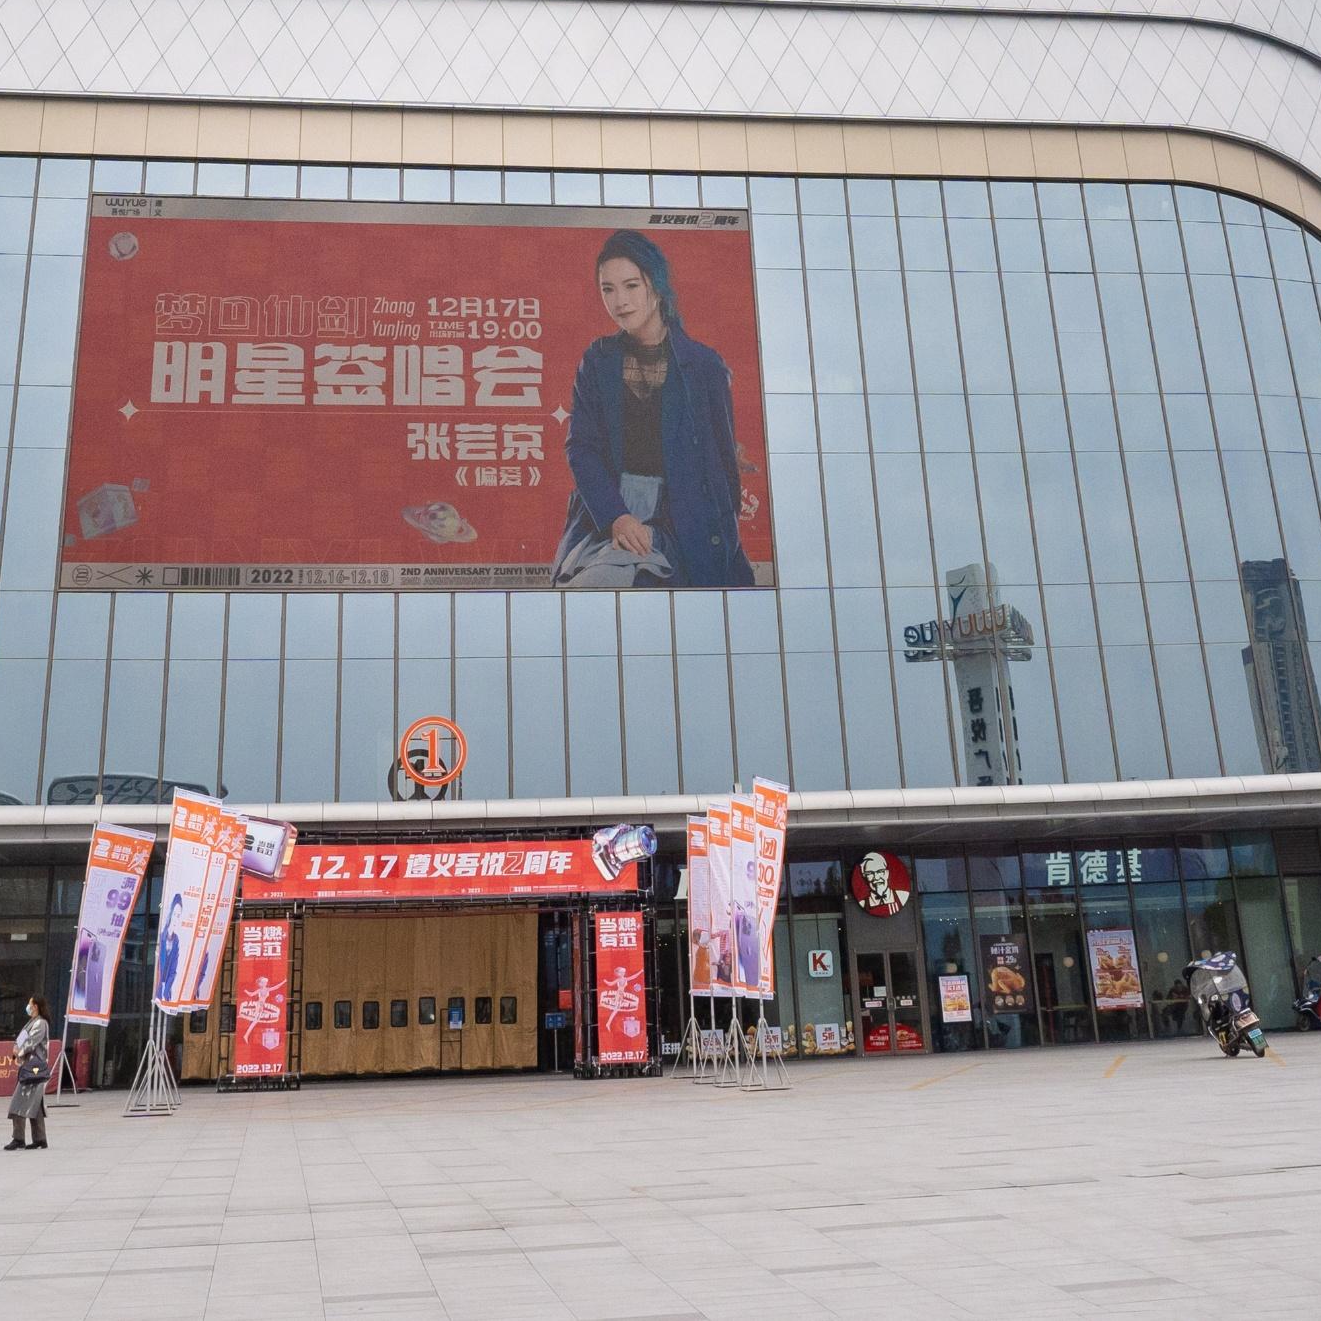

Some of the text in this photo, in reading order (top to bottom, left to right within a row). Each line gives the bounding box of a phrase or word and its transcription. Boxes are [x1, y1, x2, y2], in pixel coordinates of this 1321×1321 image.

[154, 293, 368, 339] 梦回仙剑
[372, 297, 416, 317] Zhang
[427, 296, 540, 319] 12月17日
[428, 321, 465, 329] TIME
[467, 321, 543, 339] 19:00
[150, 341, 544, 407] 明星签唱会
[407, 422, 544, 461] 张芸京
[454, 466, 542, 487] 《偏爱》
[250, 569, 294, 584] 2022
[400, 567, 421, 576] 2ND
[423, 567, 491, 576] ANNIVERSARY
[493, 567, 523, 576] ZUNYI
[305, 850, 573, 880] 12.17 遵义吾悦2周年
[1046, 848, 1142, 886] 肯德基
[106, 889, 131, 910] 99
[243, 925, 283, 942] 当燃
[599, 917, 638, 933] 当燃
[242, 942, 282, 957] 有范
[599, 933, 637, 948] 有范
[812, 952, 828, 971] K
[600, 1050, 645, 1061] 2022.12.17
[236, 1063, 283, 1074] 2022.12.17
